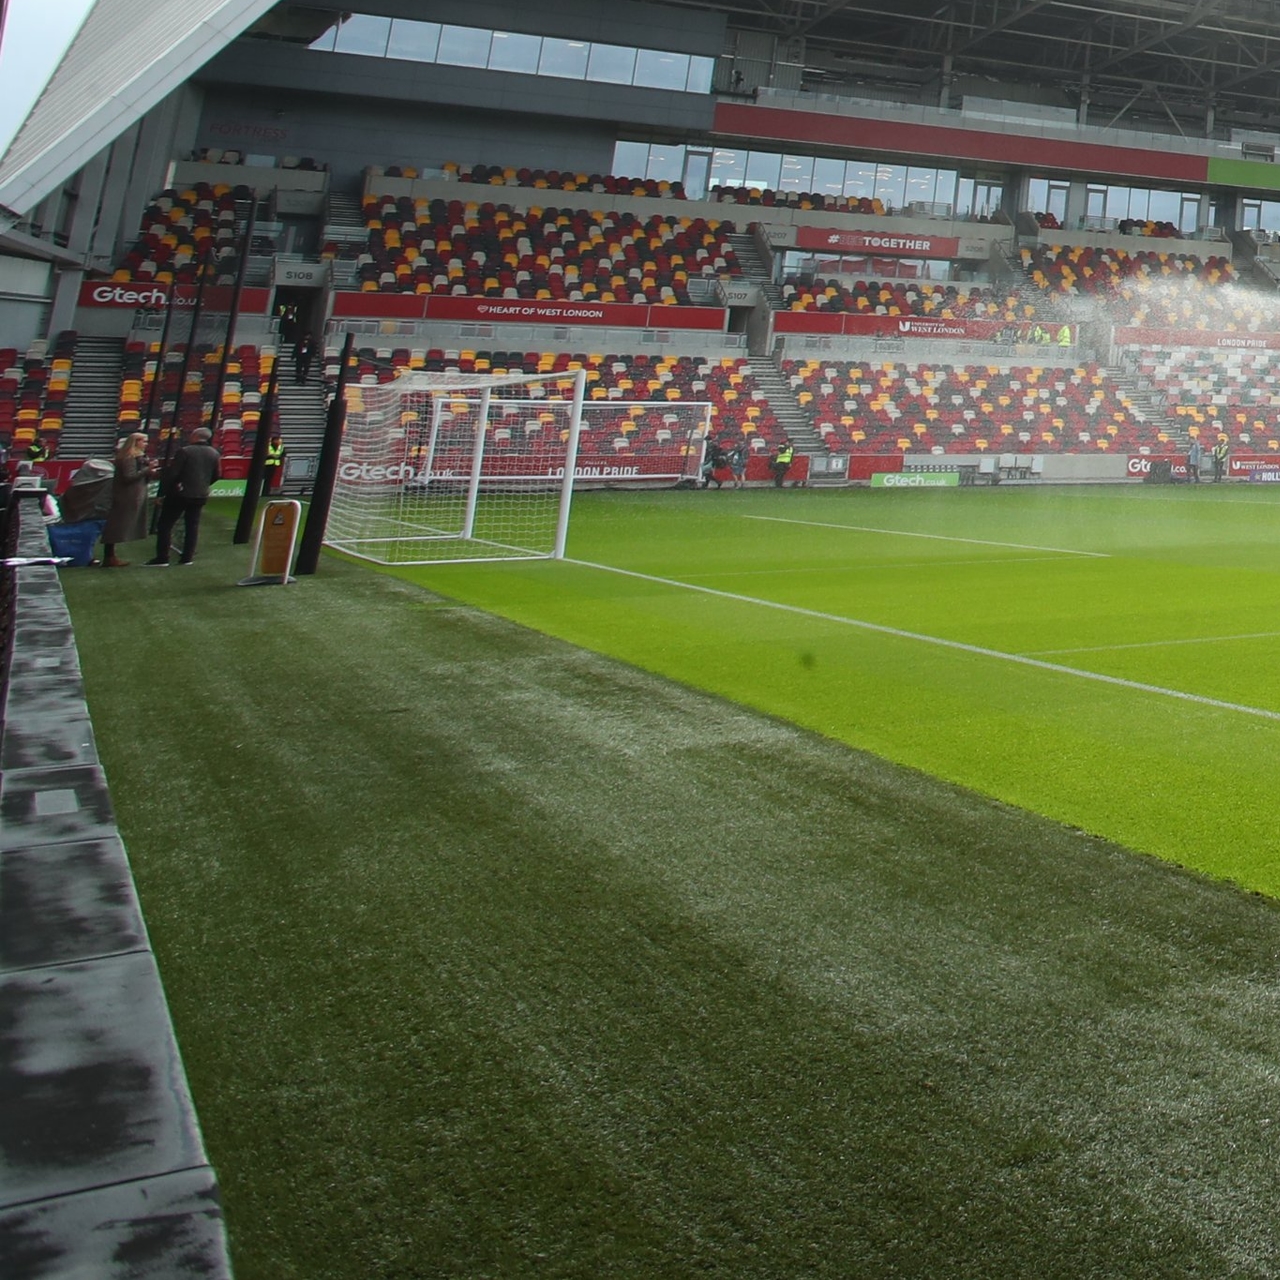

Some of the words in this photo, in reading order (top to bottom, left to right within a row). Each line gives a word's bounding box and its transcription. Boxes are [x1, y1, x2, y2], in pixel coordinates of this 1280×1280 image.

[208, 122, 288, 141] FORTRESS
[285, 270, 313, 281] S108
[728, 293, 748, 301] S107
[488, 306, 521, 315] HEART
[521, 307, 536, 315] OF
[537, 308, 562, 316] WEST
[563, 310, 603, 318] LONDON
[1217, 338, 1246, 347] LONDON
[1246, 339, 1267, 348] PRIDE
[547, 466, 600, 477] LODON
[603, 466, 640, 477] PRIDE
[883, 474, 947, 487] Gtech.co.uk
